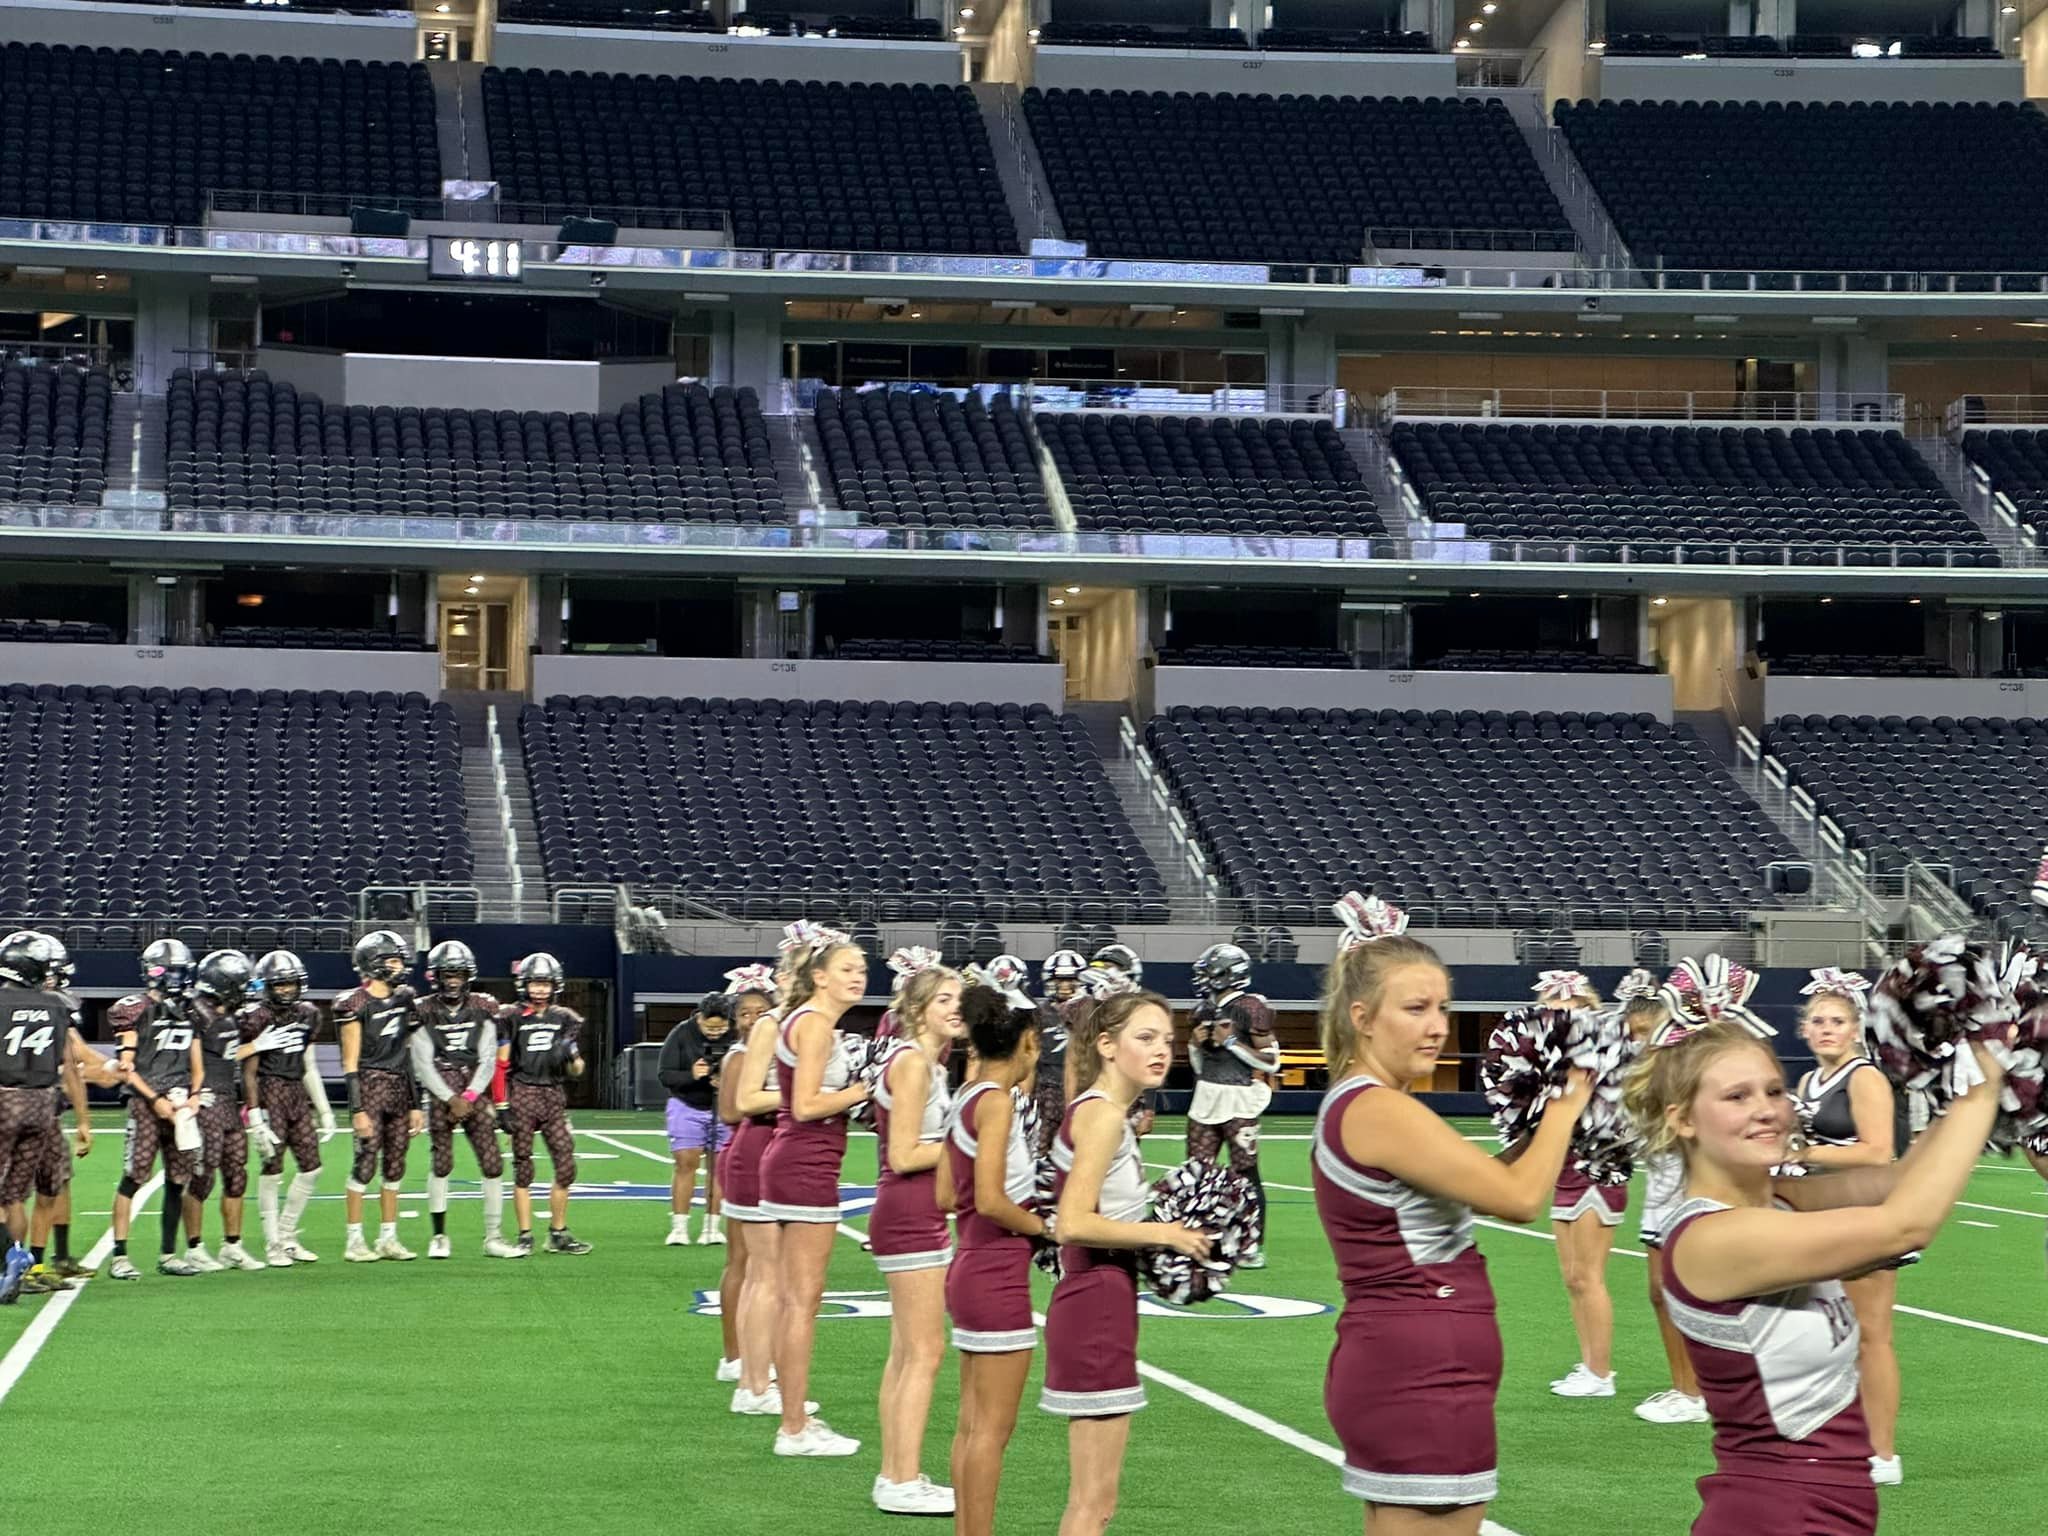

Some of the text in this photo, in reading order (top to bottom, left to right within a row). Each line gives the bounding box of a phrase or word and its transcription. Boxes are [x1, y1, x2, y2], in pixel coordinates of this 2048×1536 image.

[449, 239, 519, 275] 4:11
[3, 1025, 55, 1056] 14
[153, 1028, 193, 1051] 10
